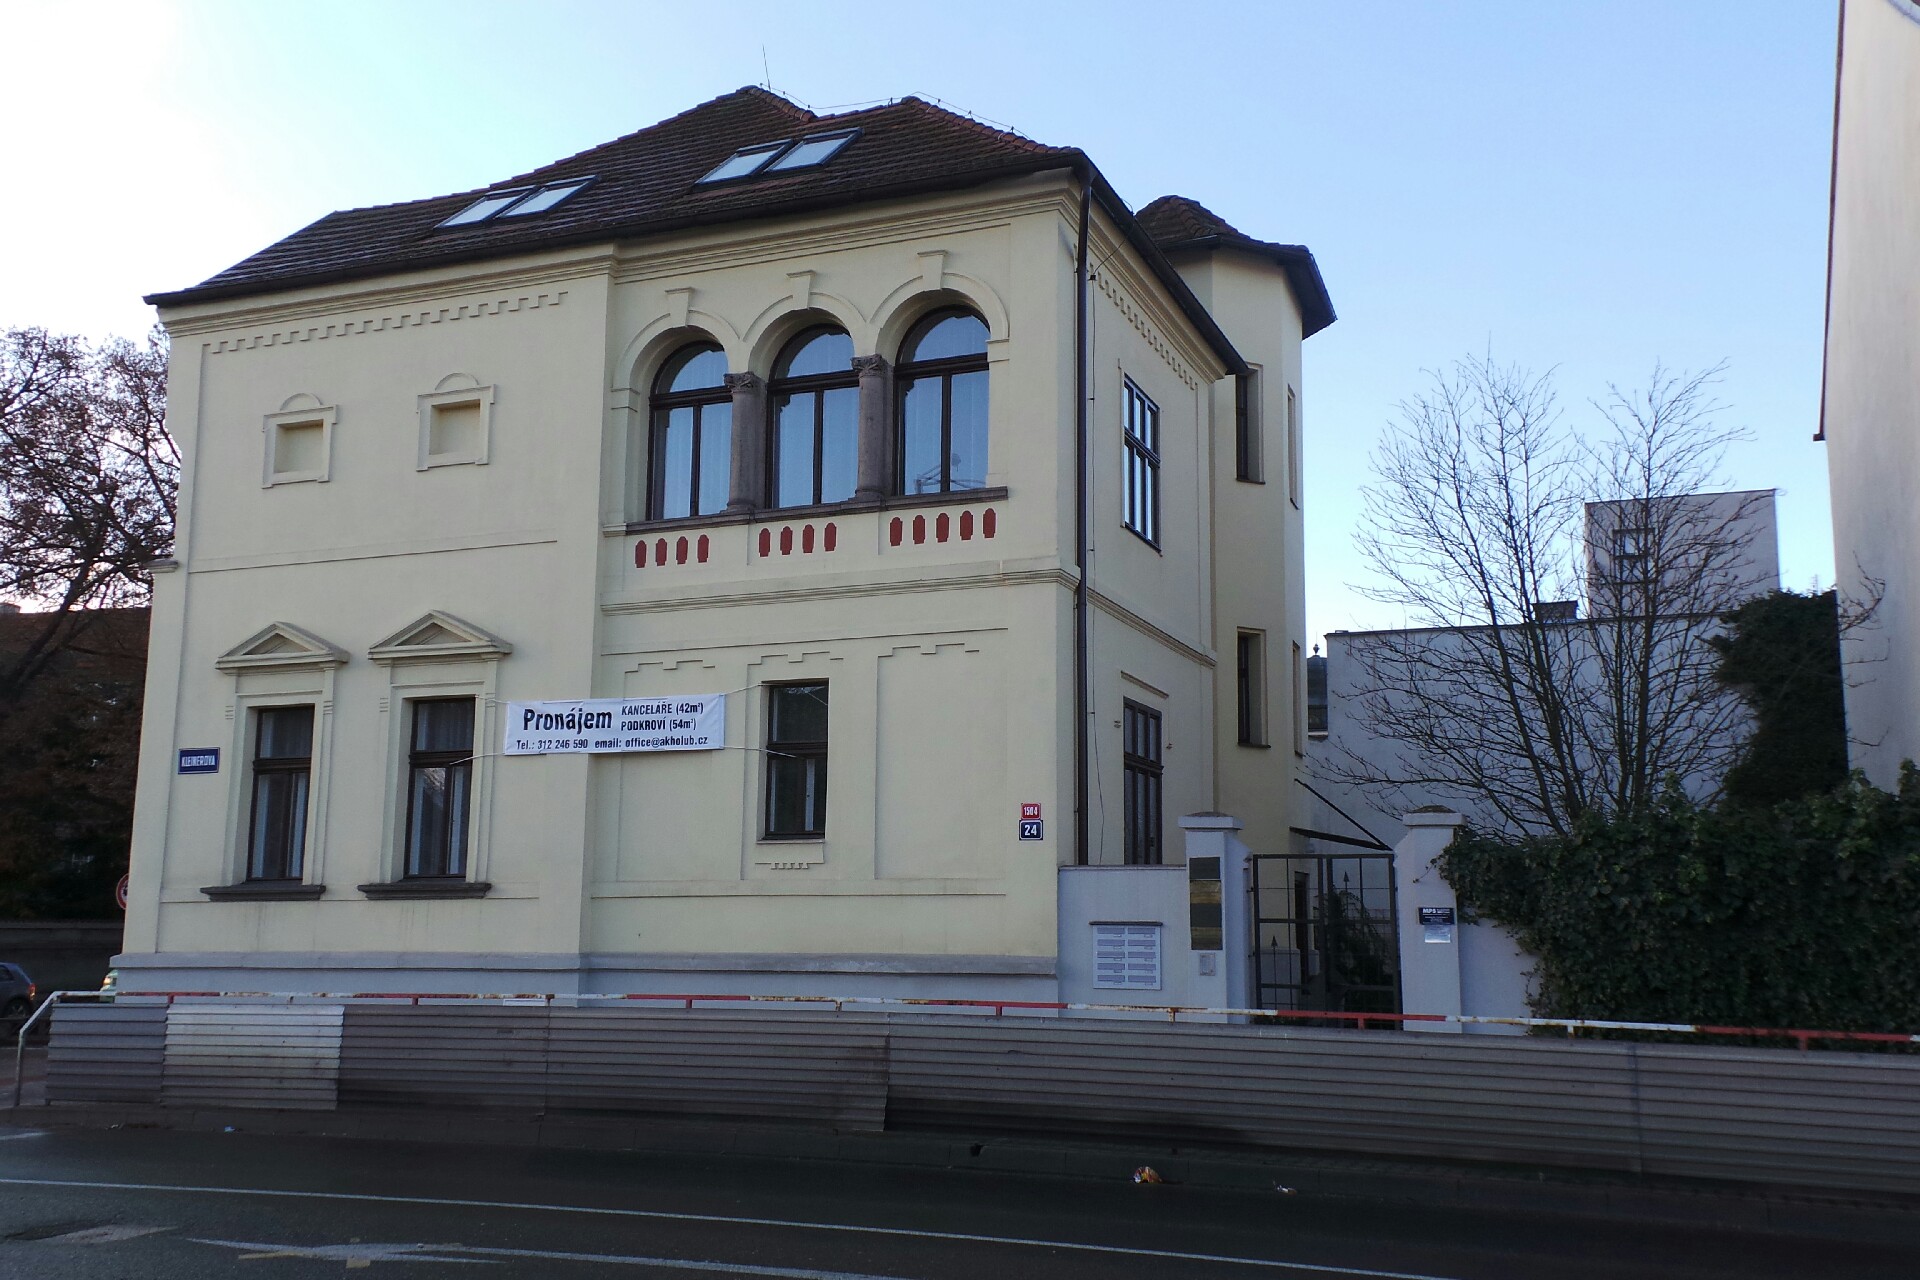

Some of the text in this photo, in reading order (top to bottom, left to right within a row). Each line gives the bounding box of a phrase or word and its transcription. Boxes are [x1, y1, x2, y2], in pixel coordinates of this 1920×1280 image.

[621, 700, 673, 716] KANCELÁŘE
[523, 707, 613, 735] Pronájem
[620, 716, 667, 732] PODKROVÍ
[516, 735, 708, 750] Tel.: 312 246 590 email: office@akholub.cz
[1024, 824, 1037, 836] 24
